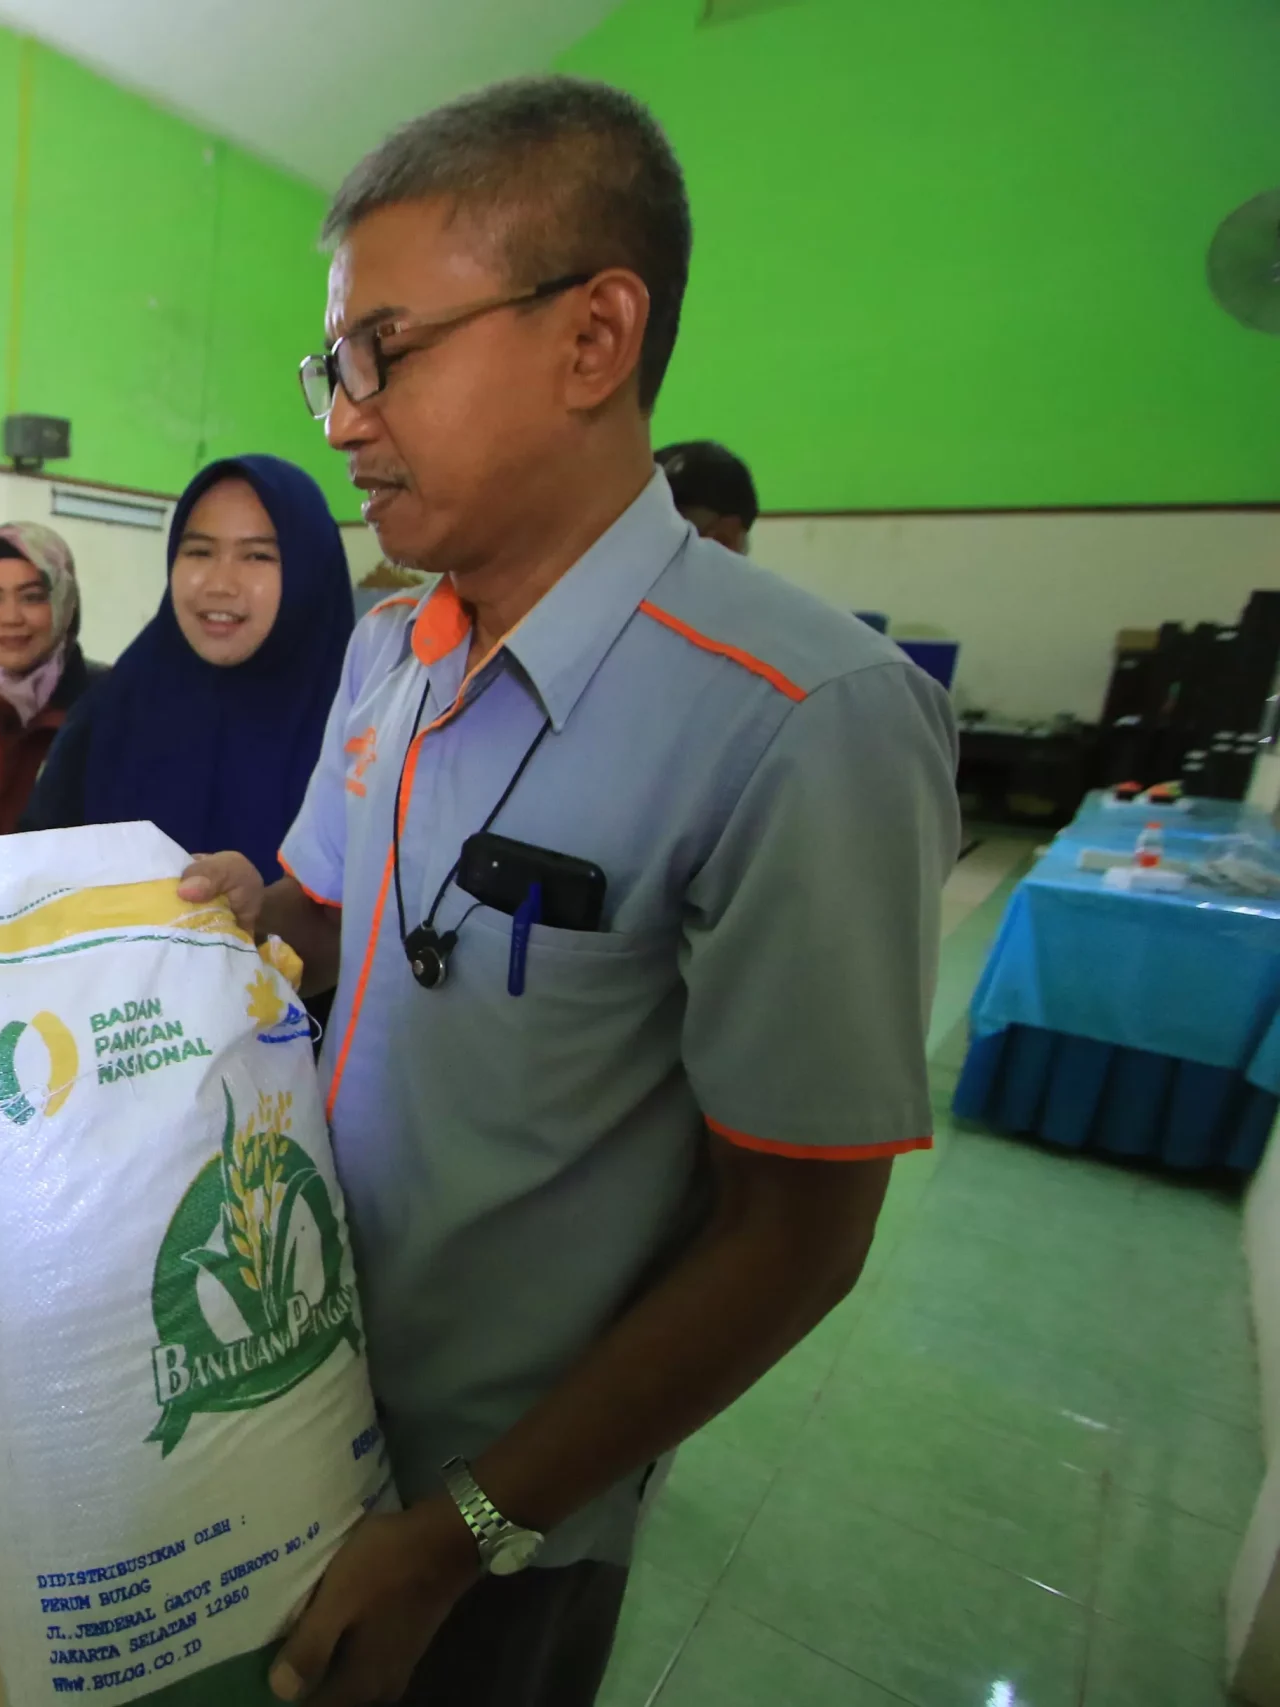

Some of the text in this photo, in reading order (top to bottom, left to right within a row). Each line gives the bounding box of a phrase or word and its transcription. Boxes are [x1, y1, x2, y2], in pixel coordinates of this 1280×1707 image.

[89, 996, 163, 1034] BADAN
[95, 1019, 184, 1058] PANGAN
[97, 1036, 213, 1085] NASIONAL
[152, 1329, 291, 1405] BANTUAN
[36, 1539, 186, 1589] DIDISTRIBUSIKAN
[193, 1518, 231, 1545] OLEH
[164, 1580, 211, 1613] GATOT
[220, 1548, 279, 1587] SUBROTO
[40, 1578, 152, 1613] PERUM BULOG
[49, 1585, 250, 1665] JAKARTA SELATAN 12950
